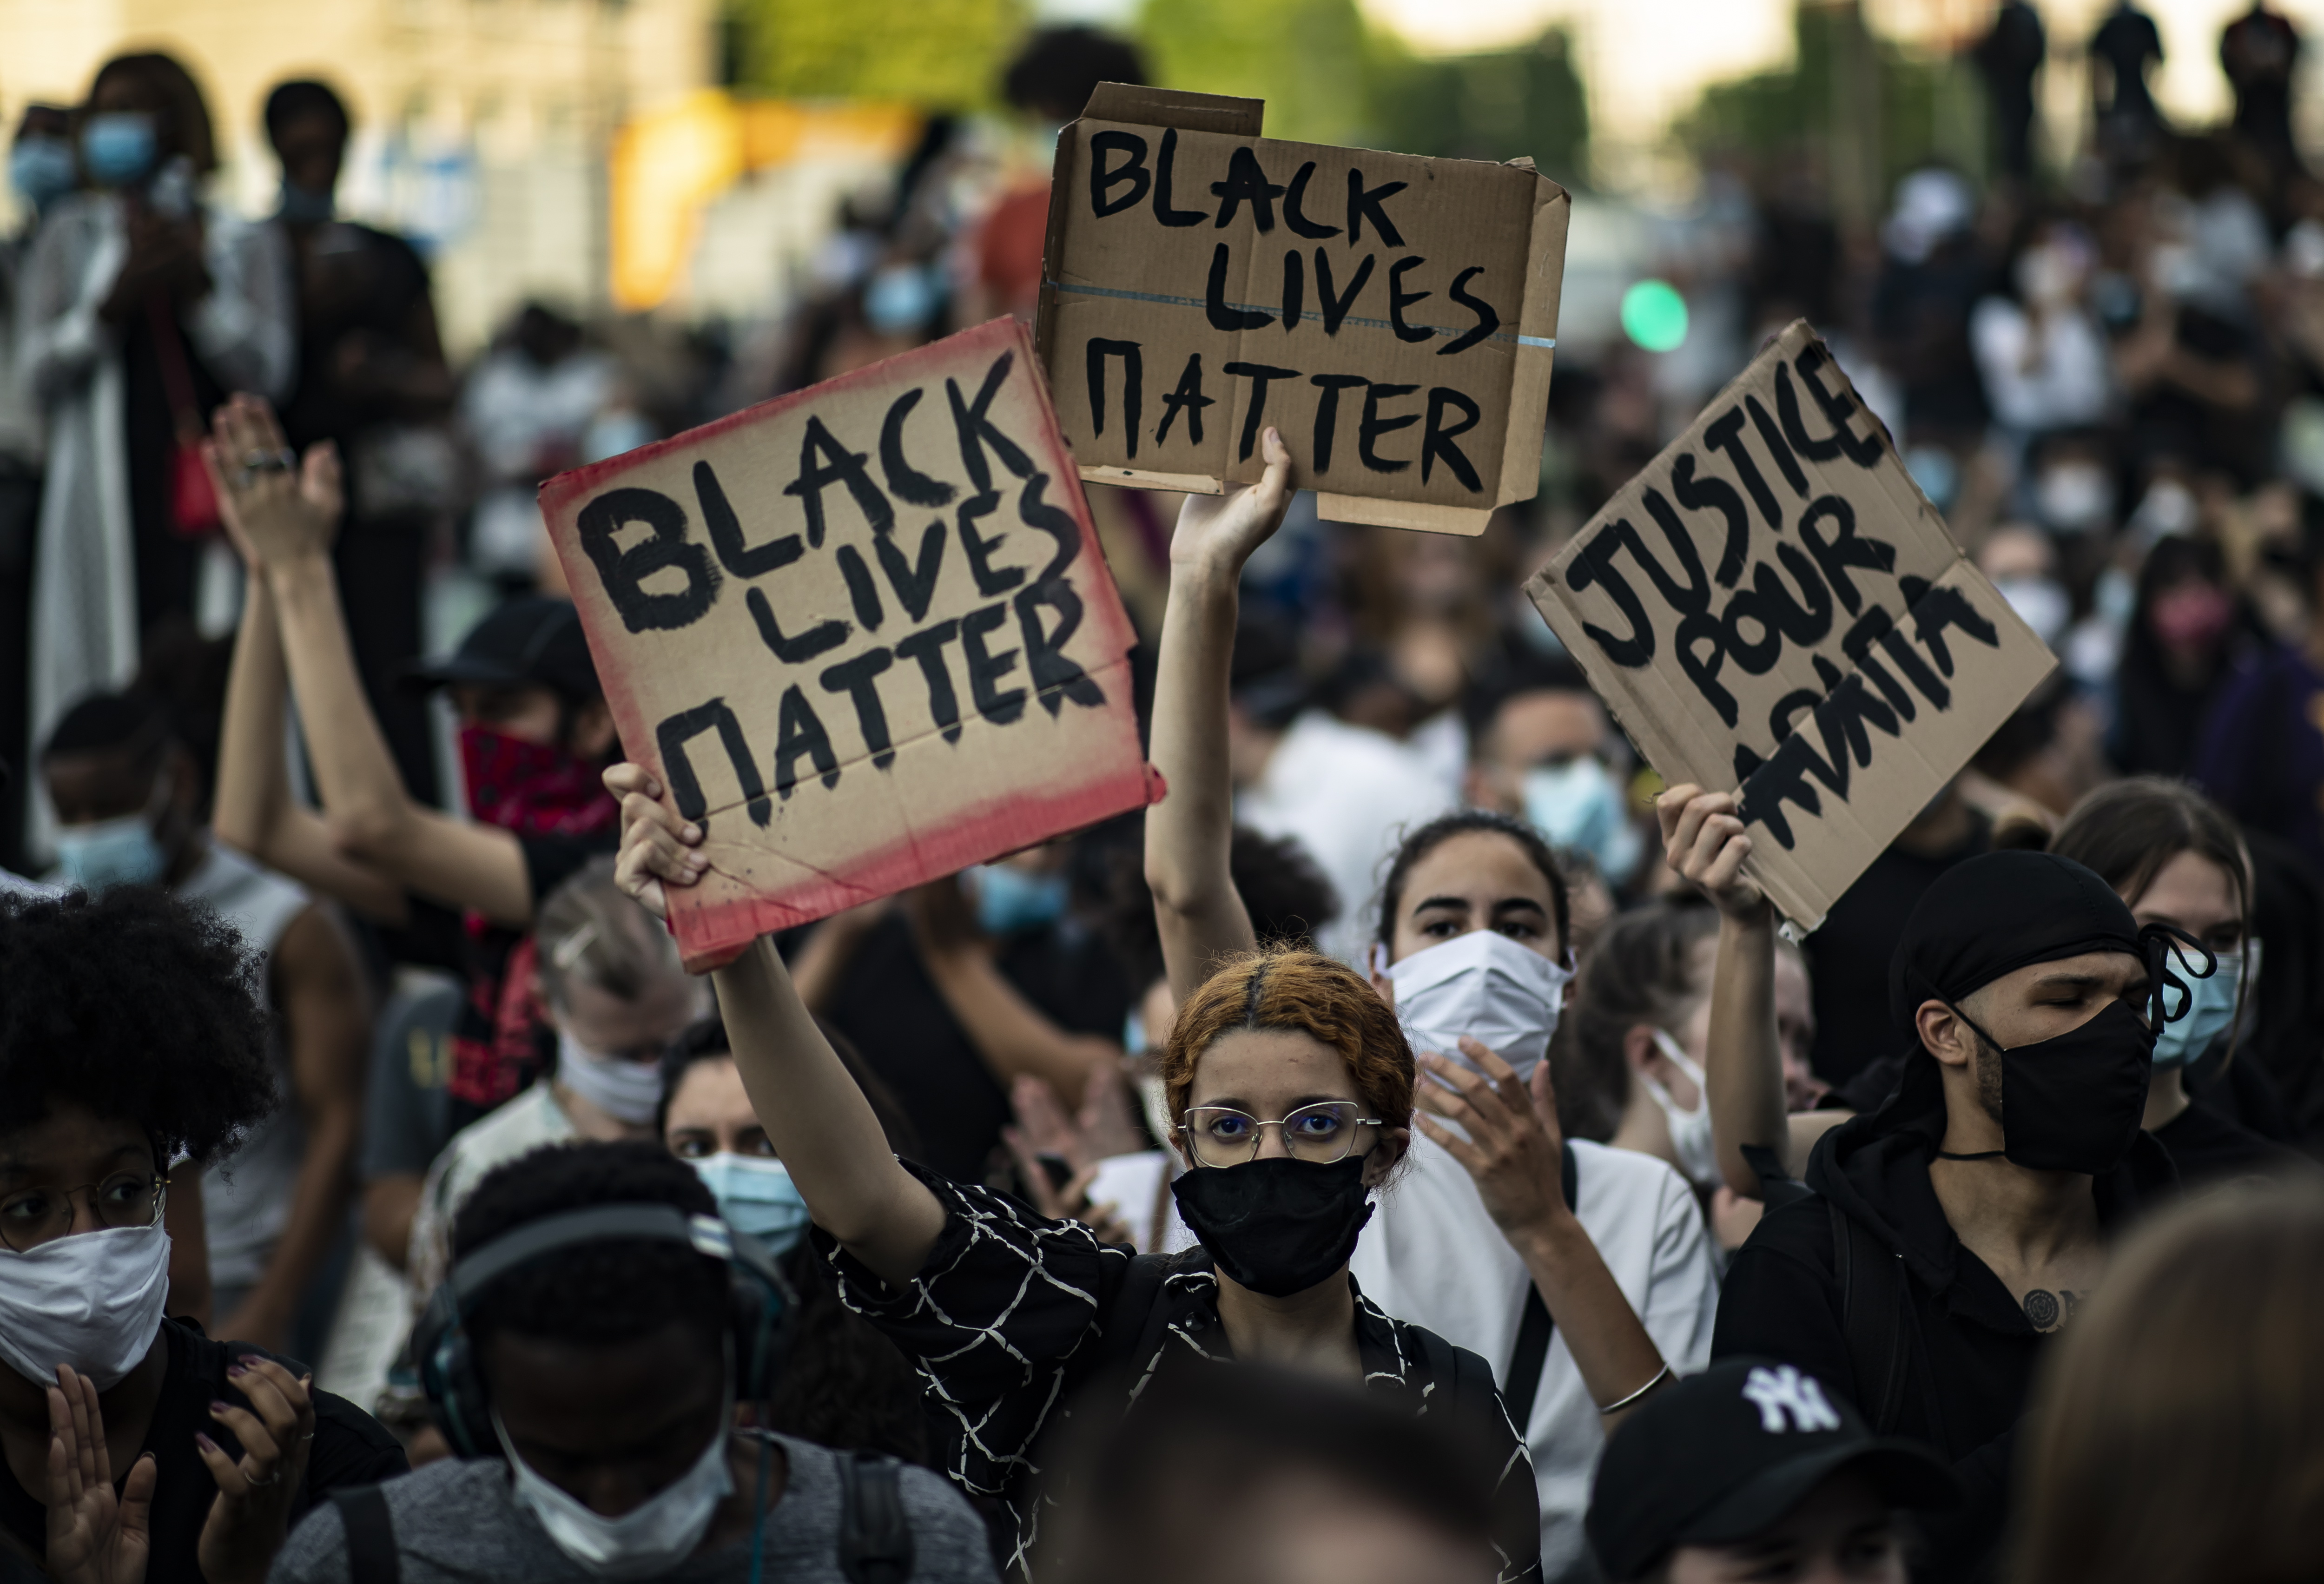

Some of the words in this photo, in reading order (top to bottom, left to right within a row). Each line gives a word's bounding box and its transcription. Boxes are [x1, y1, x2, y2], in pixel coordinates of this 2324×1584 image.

[1090, 128, 1409, 248] BLACK
[1206, 242, 1500, 356] LIVES
[577, 349, 1039, 634] BLACK
[746, 473, 1083, 664] LIVES
[1565, 344, 1886, 668] JUSTICE
[1674, 494, 1896, 729] POUR
